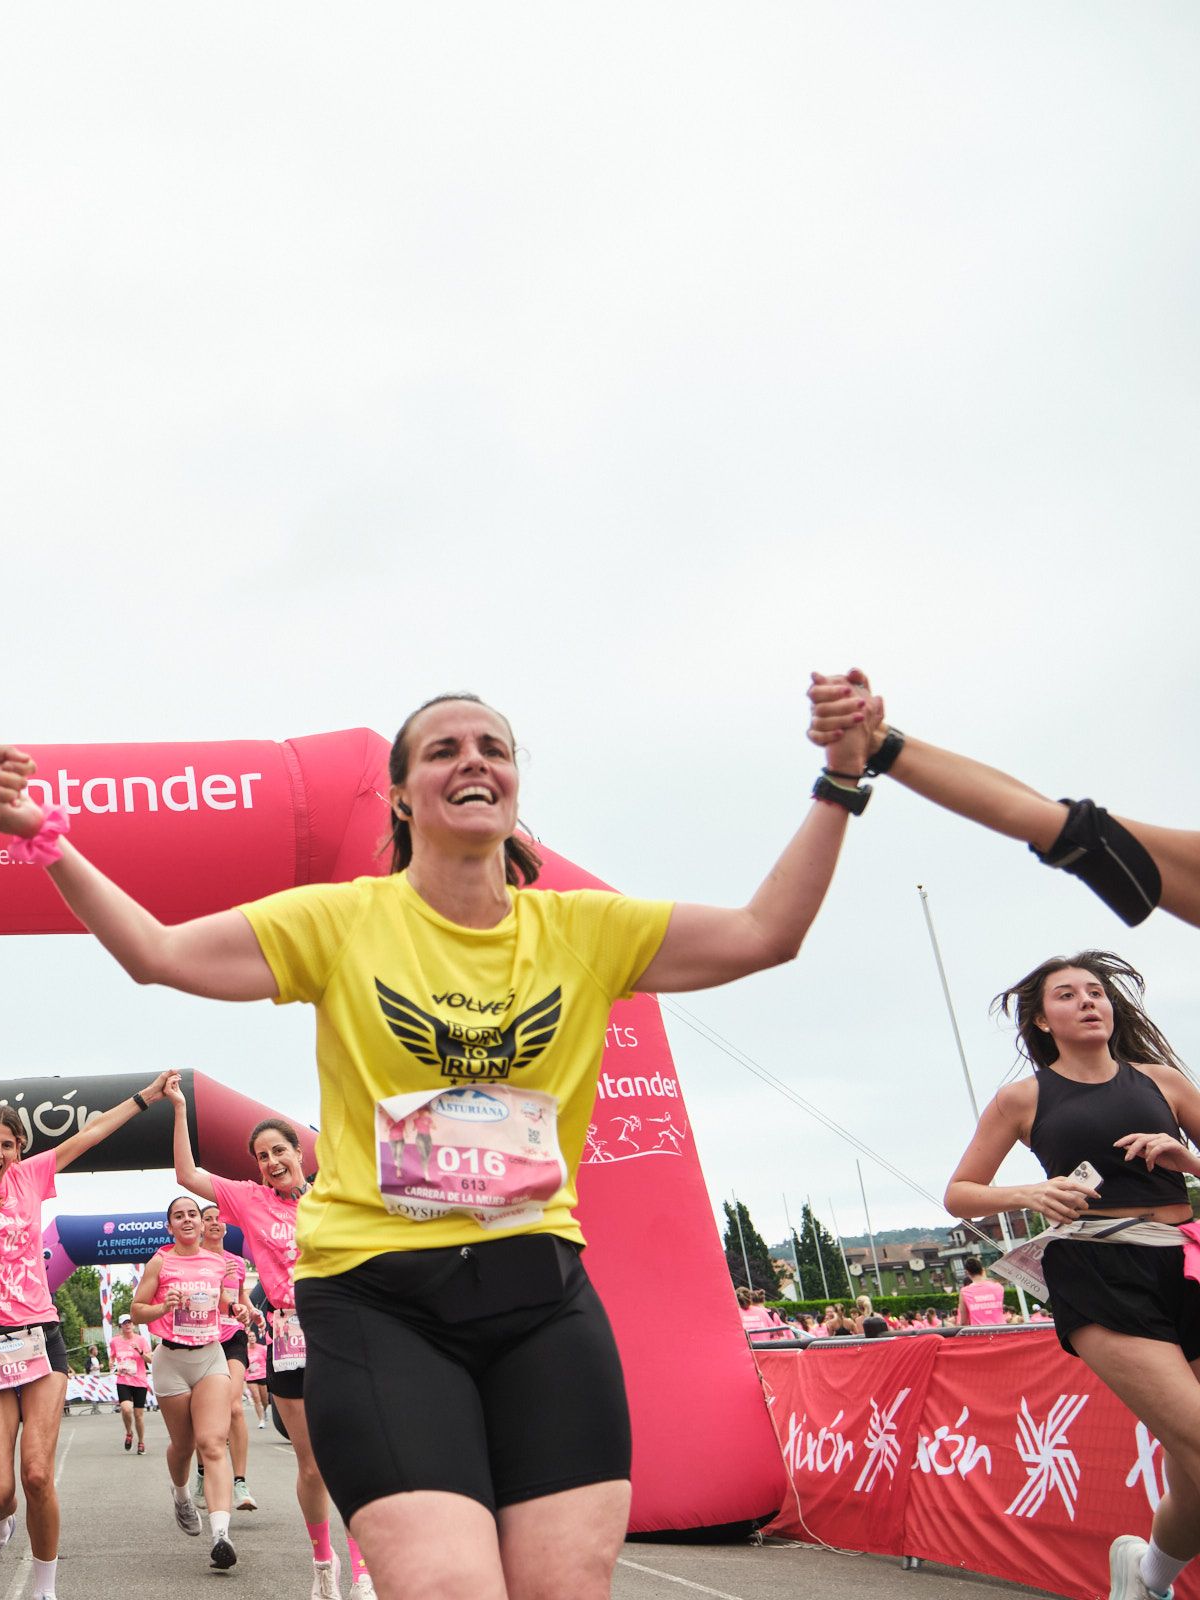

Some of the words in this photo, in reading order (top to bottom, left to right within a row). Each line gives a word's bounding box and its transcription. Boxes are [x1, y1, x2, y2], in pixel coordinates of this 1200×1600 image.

[463, 1044, 488, 1060] TO
[447, 1058, 506, 1077] RUN
[435, 1099, 503, 1117] ASTURIANA
[436, 1147, 507, 1178] 016
[461, 1178, 487, 1192] 613
[404, 1186, 446, 1201] CARRERA
[447, 1191, 460, 1202] DE
[461, 1193, 474, 1203] LA
[117, 1220, 164, 1233] octopus
[97, 1240, 108, 1248] LA
[109, 1236, 147, 1247] ENERGÍA
[147, 1236, 171, 1245] PARA
[190, 1310, 209, 1319] 016
[2, 1360, 28, 1376] 016
